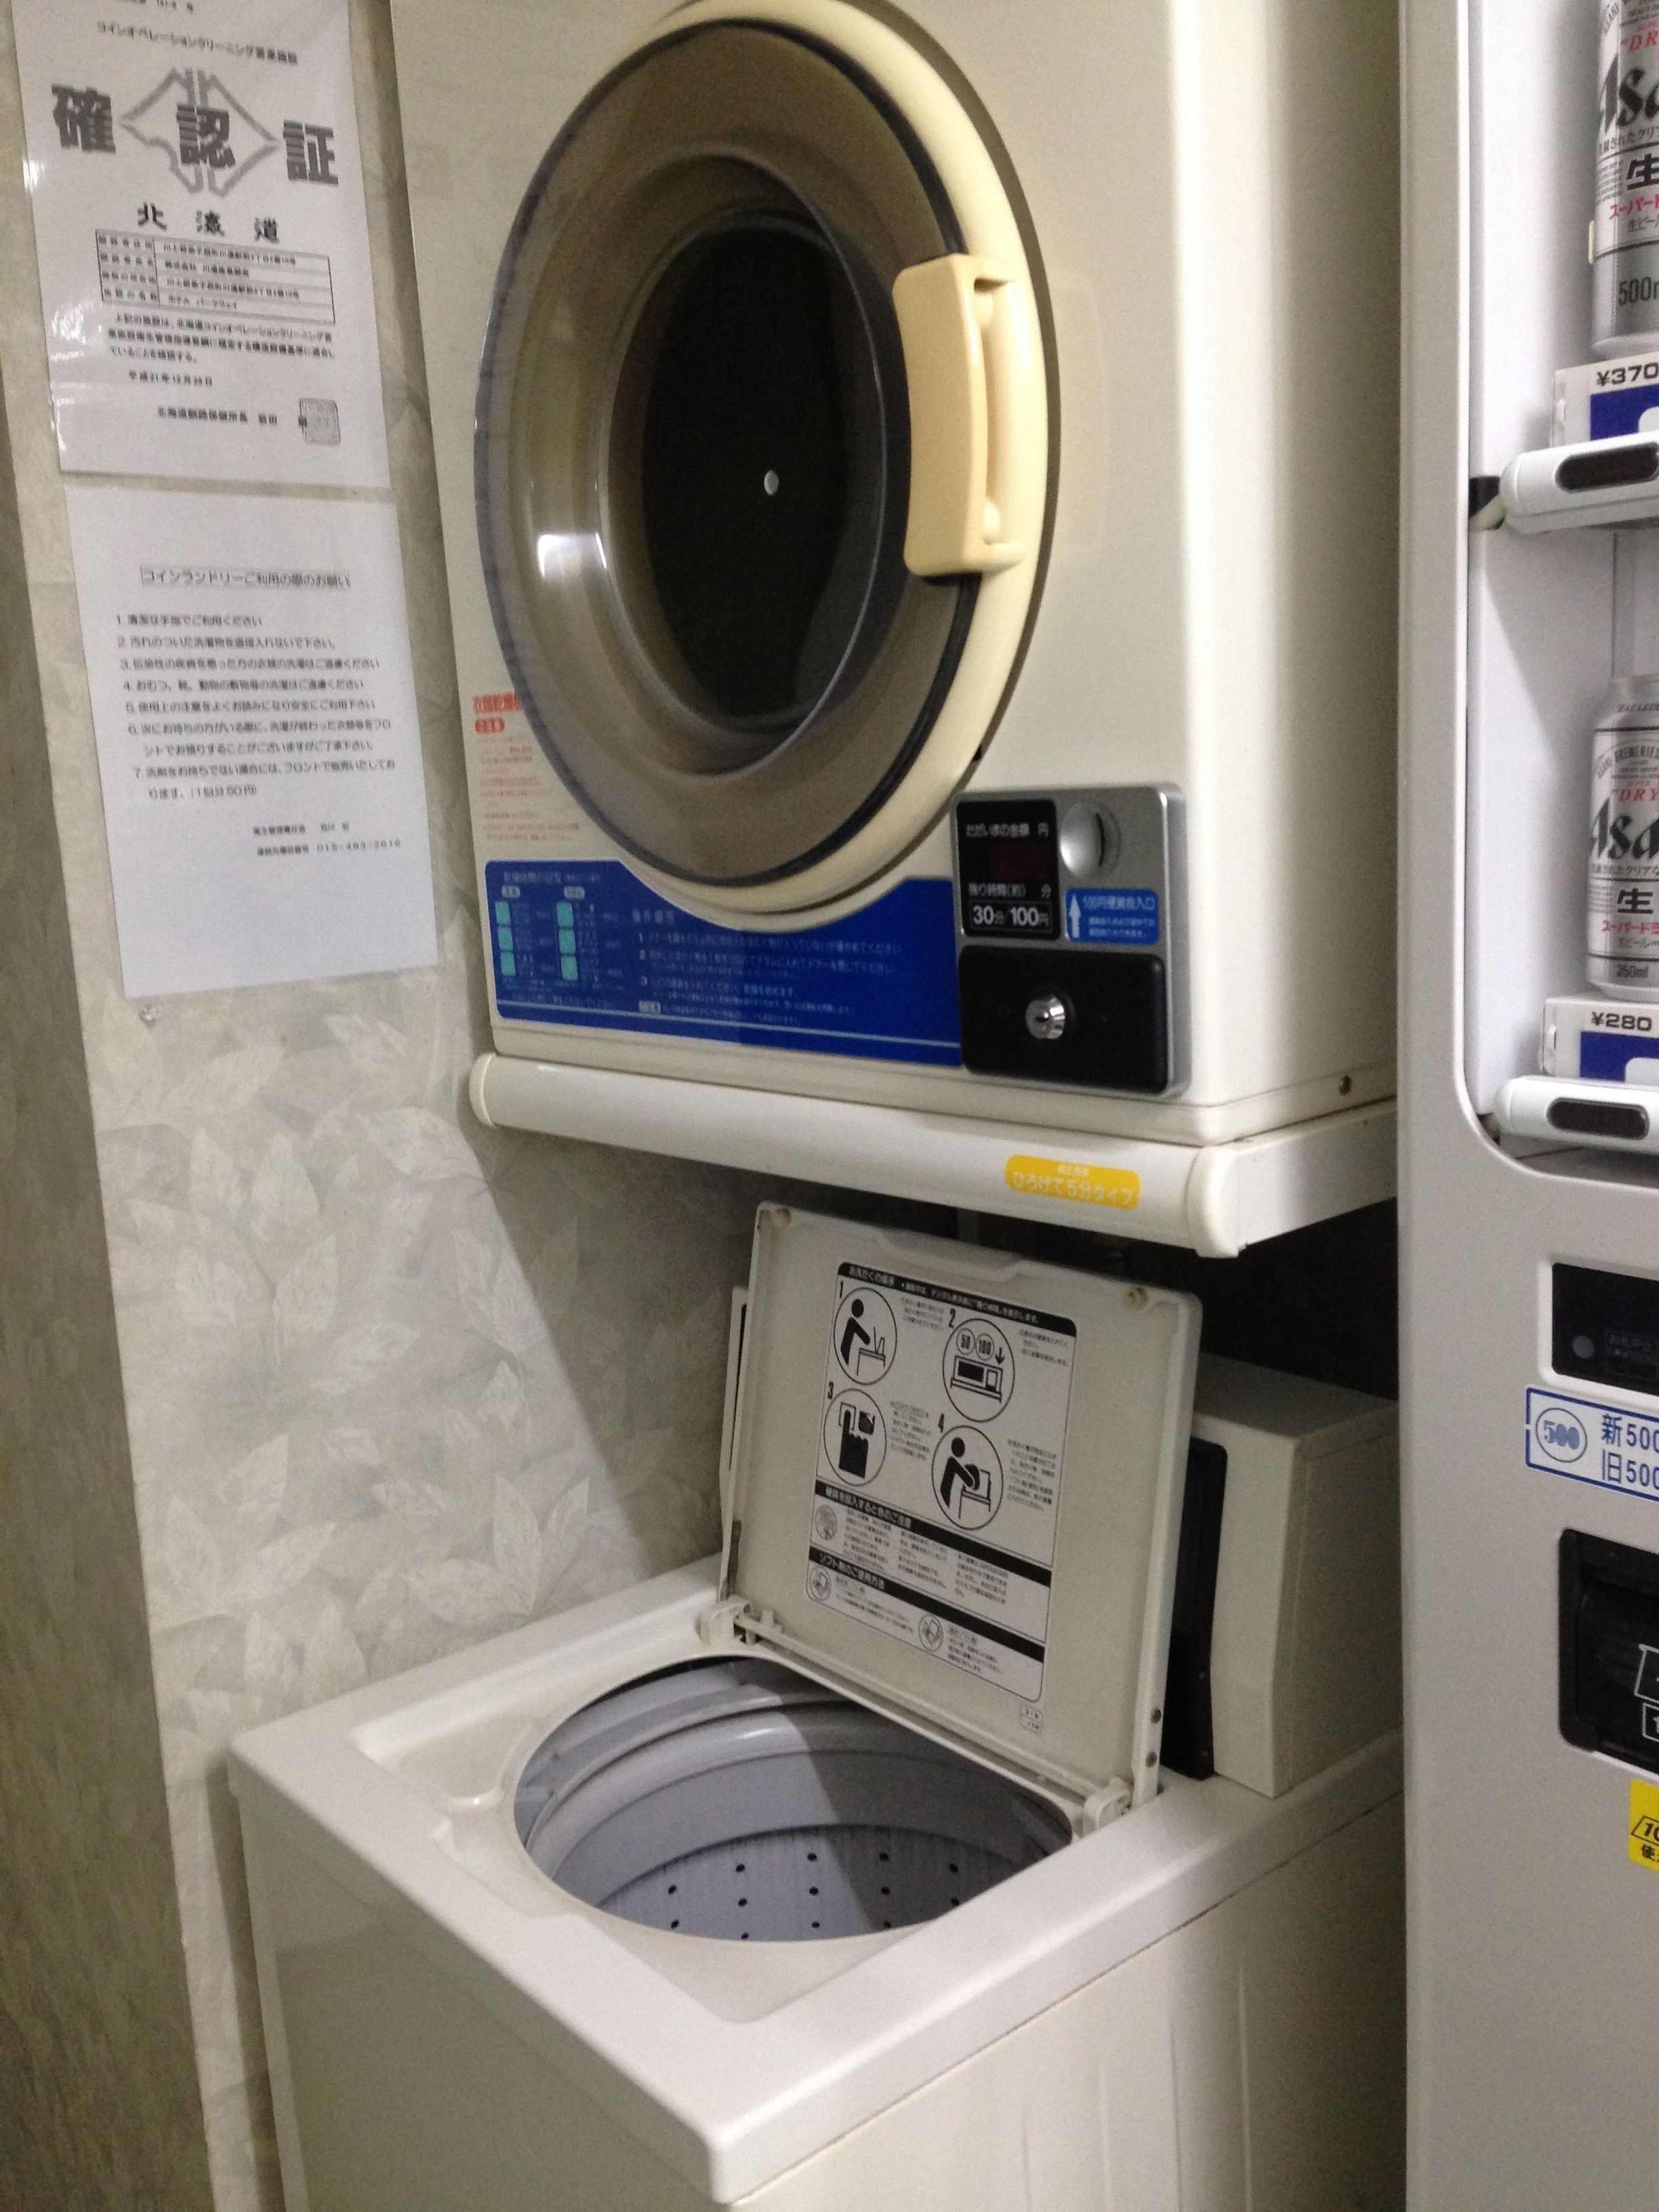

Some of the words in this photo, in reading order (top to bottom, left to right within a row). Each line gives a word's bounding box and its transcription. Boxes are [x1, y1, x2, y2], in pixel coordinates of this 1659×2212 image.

[1626, 153, 1659, 190] 生
[1596, 362, 1659, 387] ¥370
[1038, 822, 1049, 838] 円
[1041, 885, 1051, 899] 分
[1618, 888, 1654, 914] 生
[1591, 1010, 1652, 1031] ¥280
[1012, 1170, 1134, 1205] ひろげて5分タイプ
[838, 1281, 844, 1298] 1
[948, 1308, 956, 1328] 2
[960, 1334, 971, 1350] 50
[979, 1338, 991, 1356] 100
[827, 1382, 834, 1399] 3
[938, 1412, 945, 1433] 4
